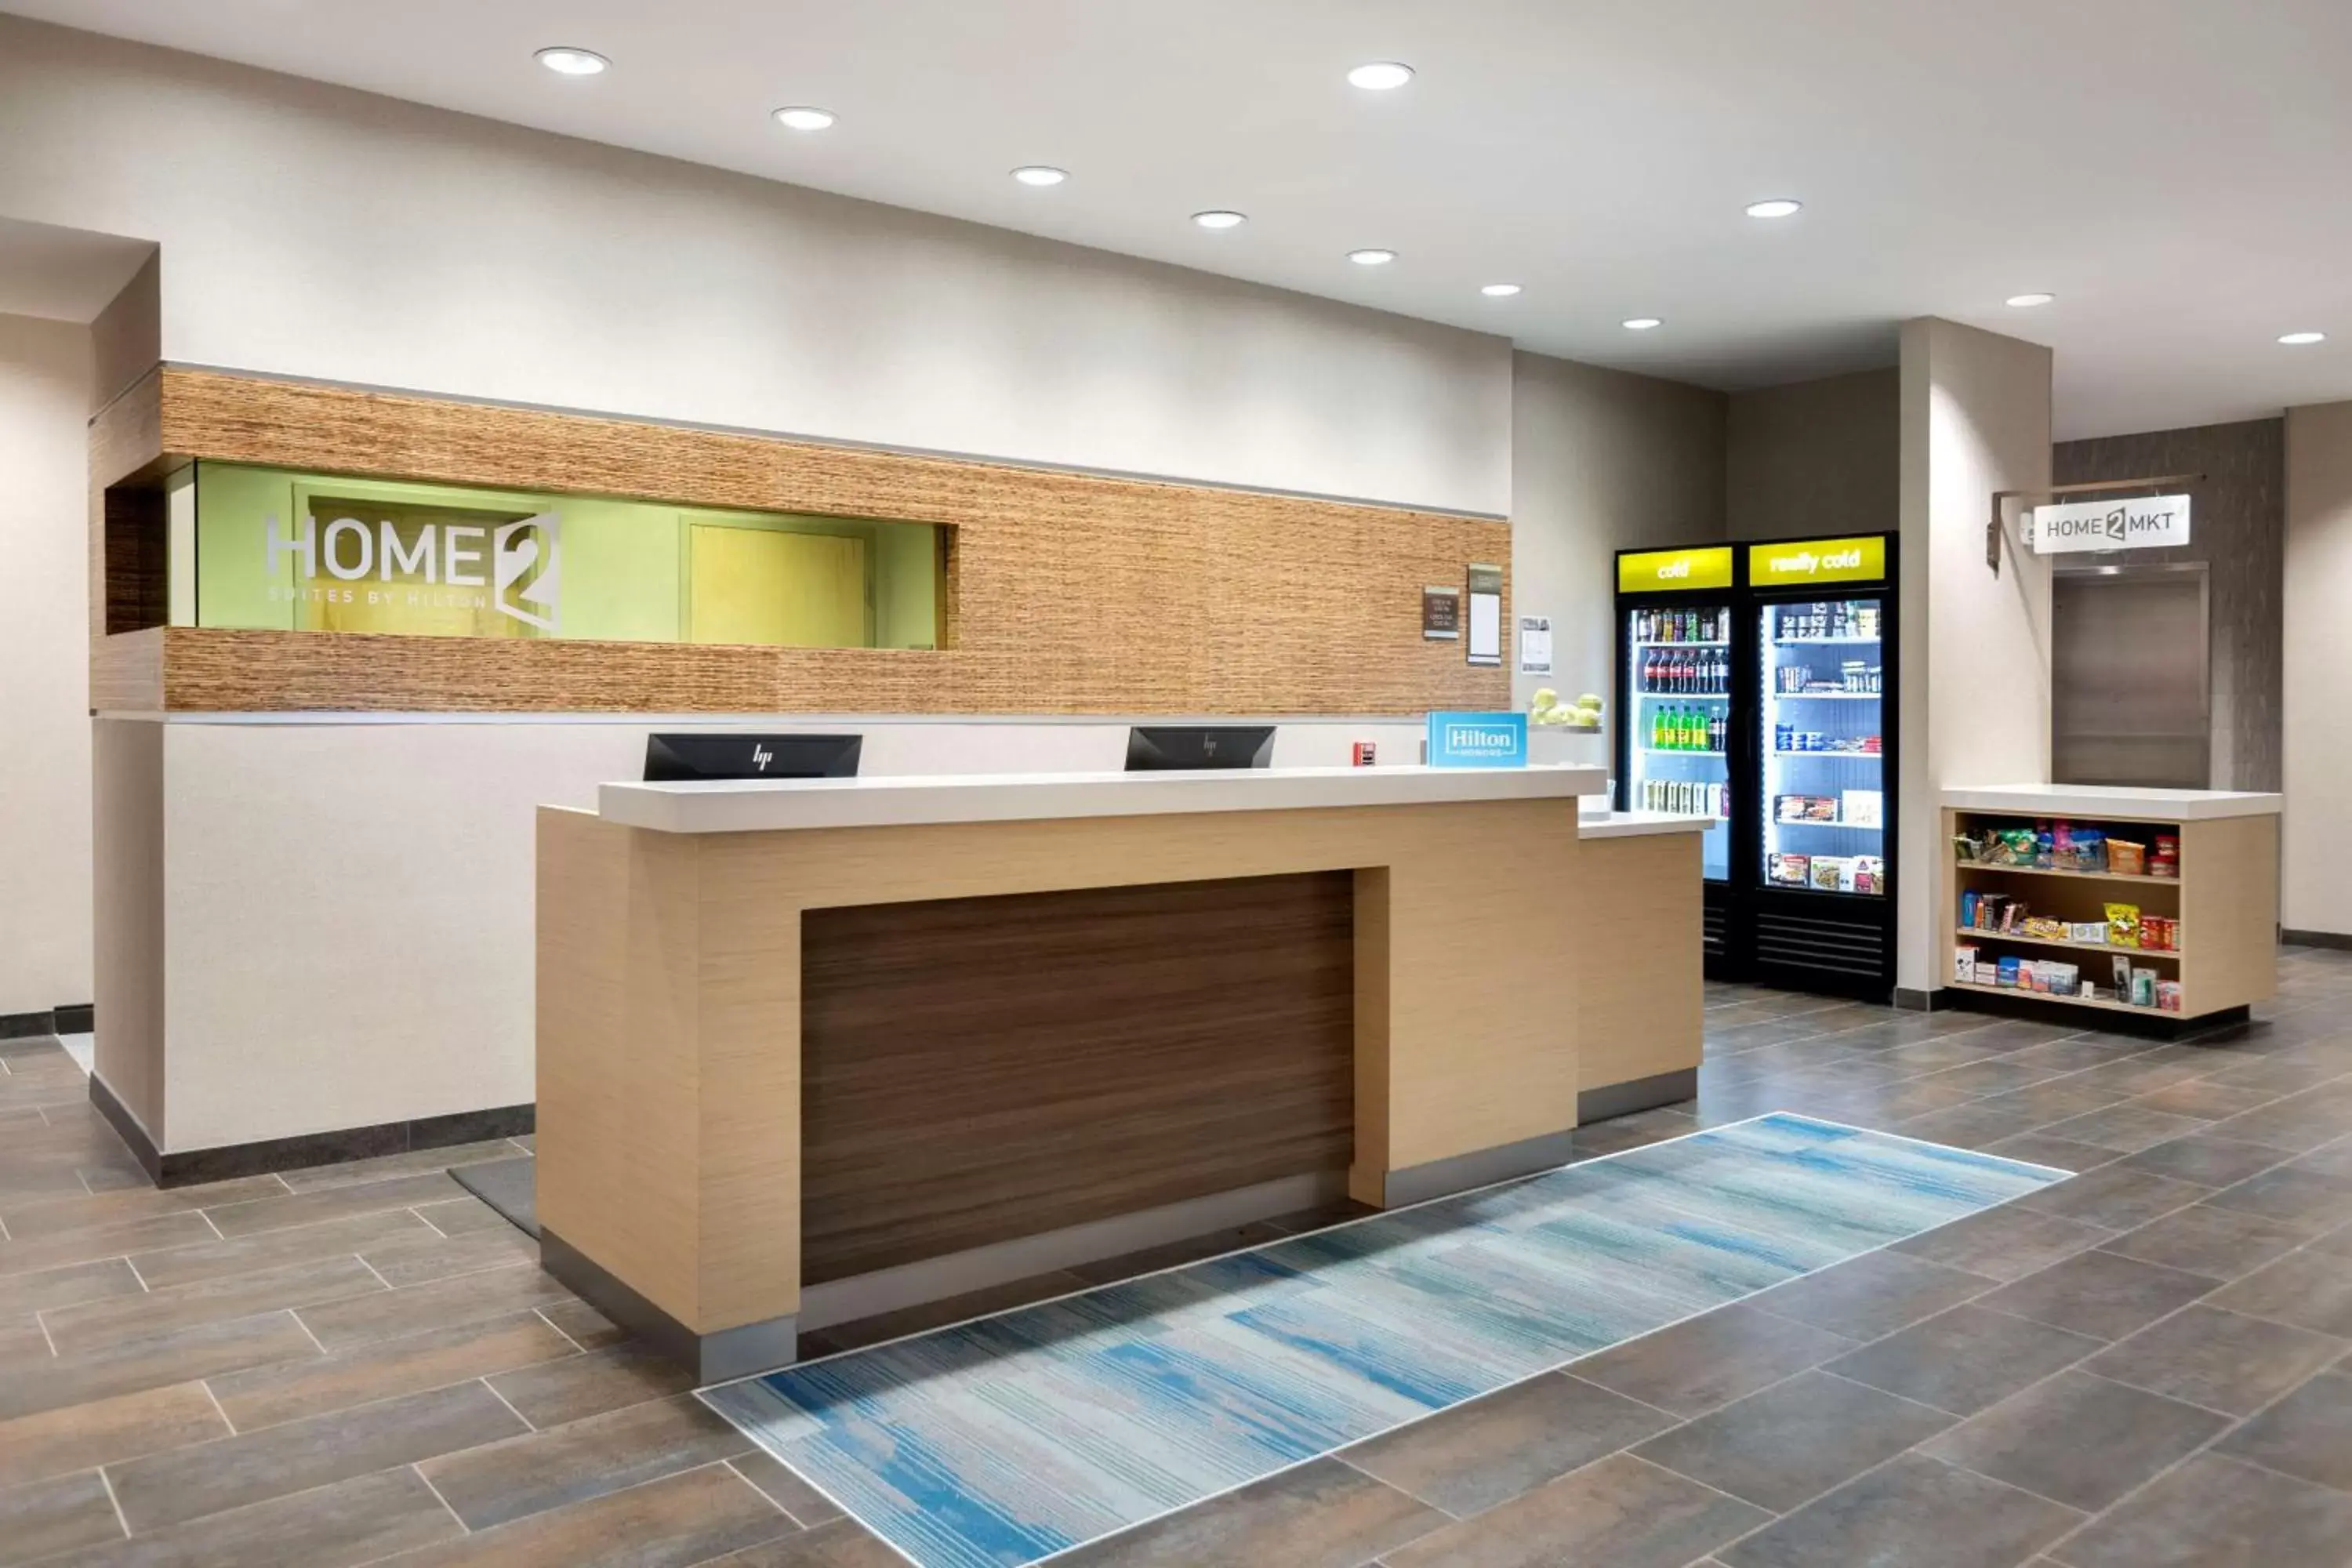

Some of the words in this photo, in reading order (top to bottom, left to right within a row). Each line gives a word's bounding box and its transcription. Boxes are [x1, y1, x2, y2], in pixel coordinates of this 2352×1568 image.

[1657, 560, 1690, 579] cold
[1769, 552, 1819, 575] really
[1821, 549, 1860, 569] cold
[268, 586, 354, 603] SUITES
[367, 592, 393, 605] BY
[407, 593, 486, 609] HILTON
[1453, 730, 1511, 747] Hilton
[753, 743, 772, 771] hp
